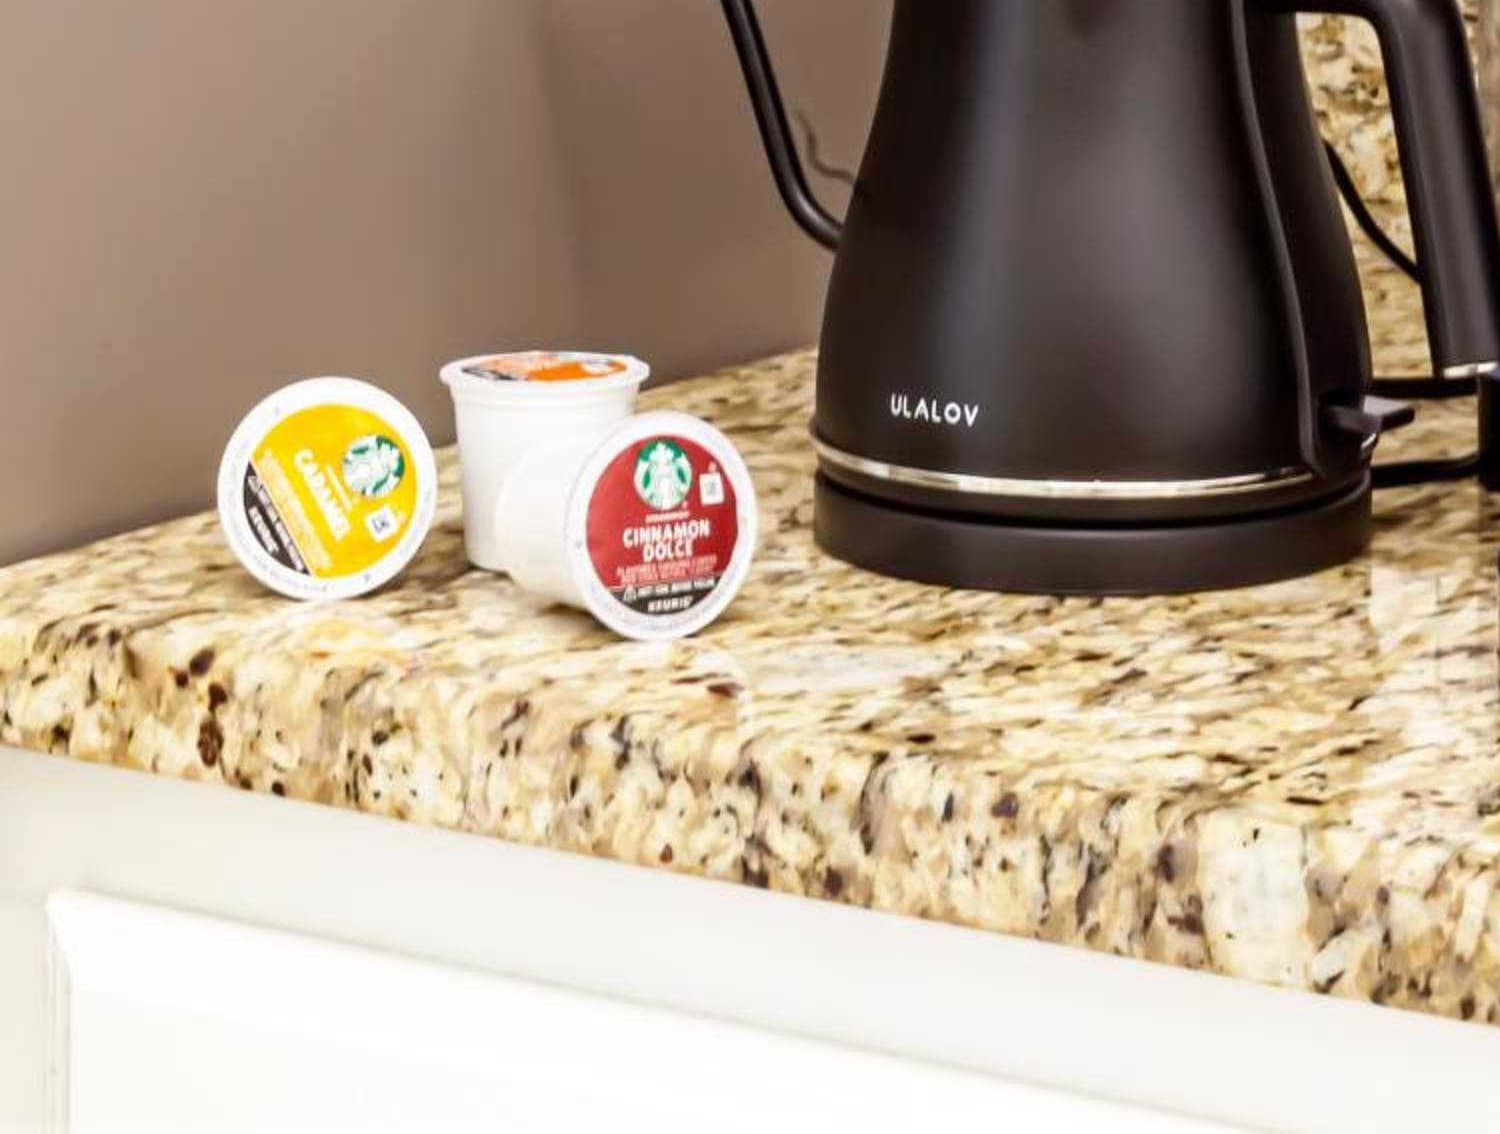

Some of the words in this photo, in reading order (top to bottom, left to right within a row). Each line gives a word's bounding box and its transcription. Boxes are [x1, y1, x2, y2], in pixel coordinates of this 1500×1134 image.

[890, 393, 979, 427] ULALOV
[622, 518, 711, 548] CINNAMON
[642, 539, 694, 563] DOLCE
